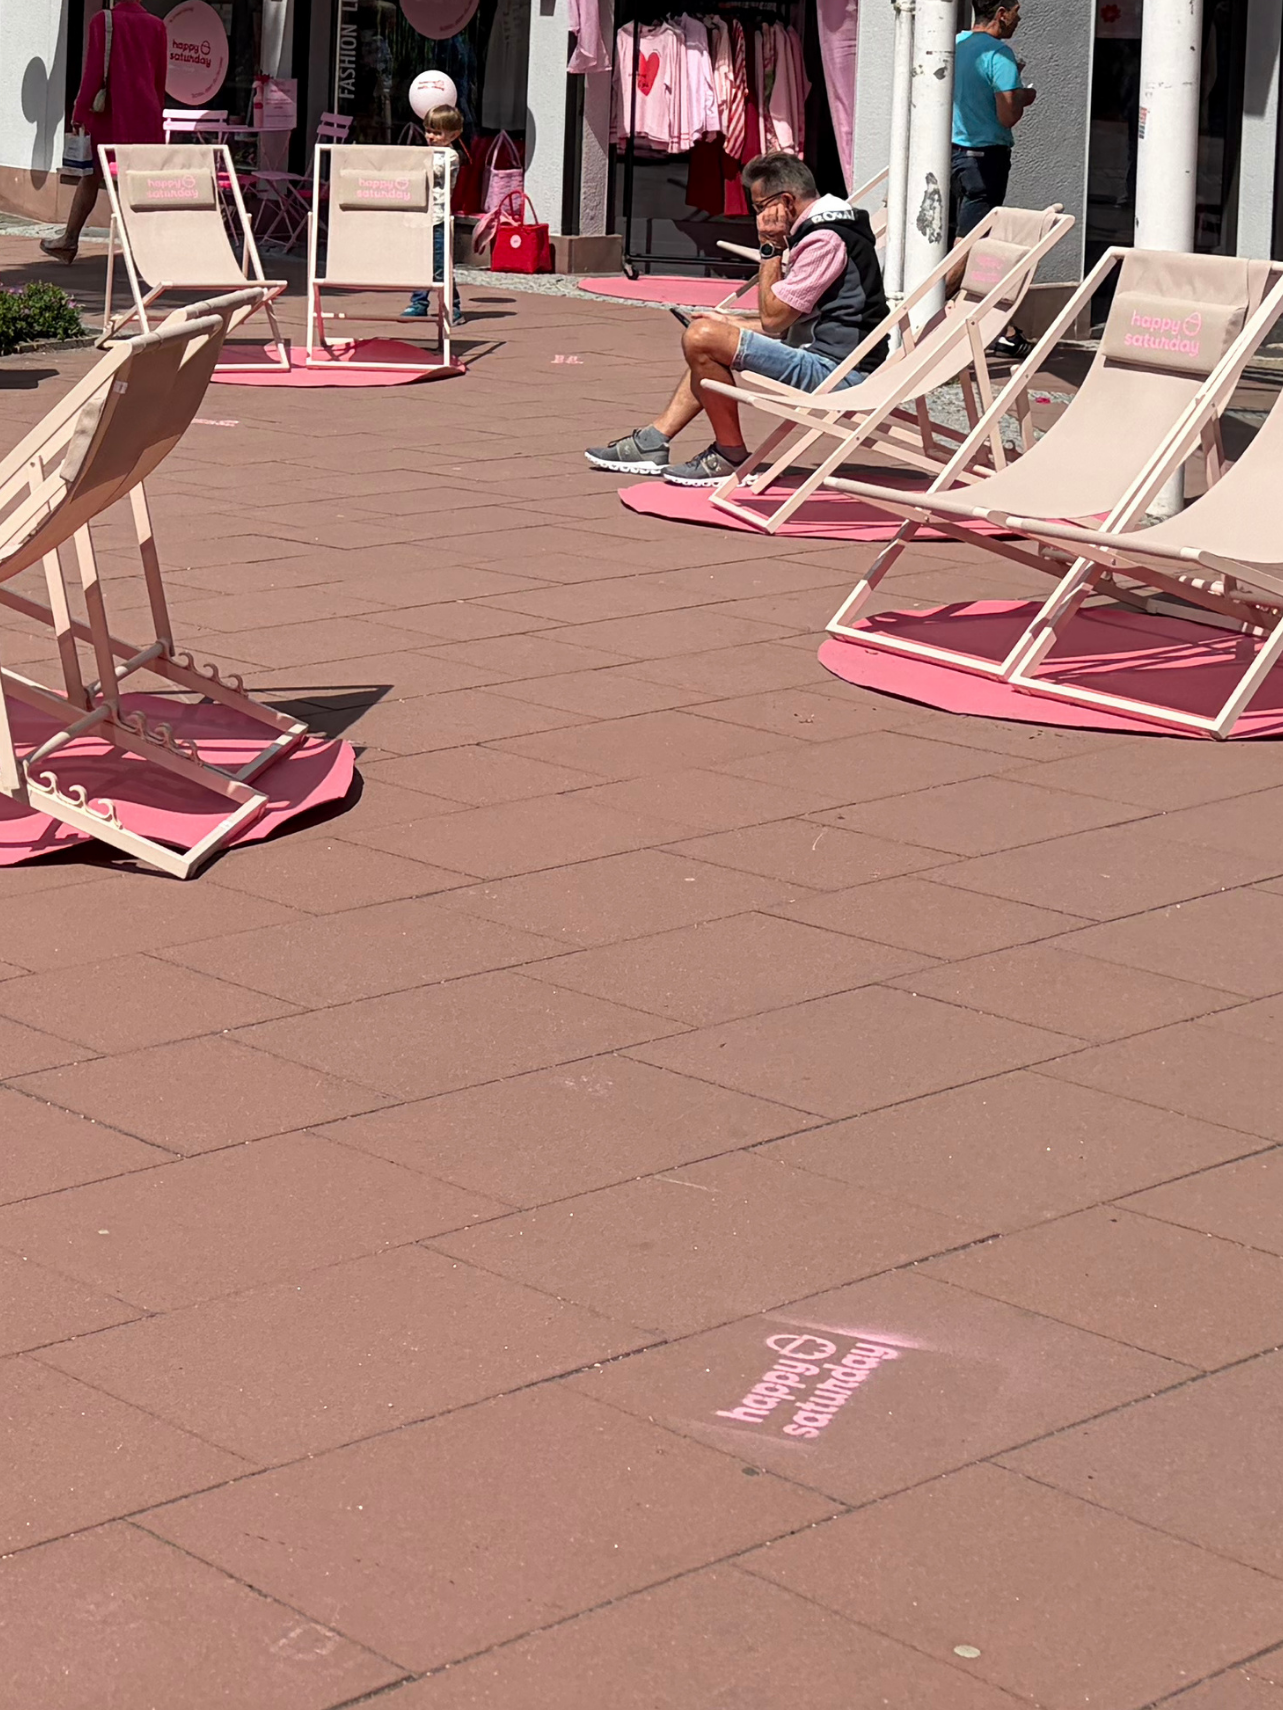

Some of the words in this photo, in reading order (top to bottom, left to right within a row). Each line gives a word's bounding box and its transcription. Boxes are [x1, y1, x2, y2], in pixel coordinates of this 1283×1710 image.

[172, 39, 199, 54] happy
[169, 51, 212, 68] saturday
[339, 24, 357, 99] FASHION
[1131, 310, 1181, 335] happy
[1124, 332, 1200, 357] saturday
[714, 1358, 820, 1423] happy
[782, 1342, 900, 1438] saturday
